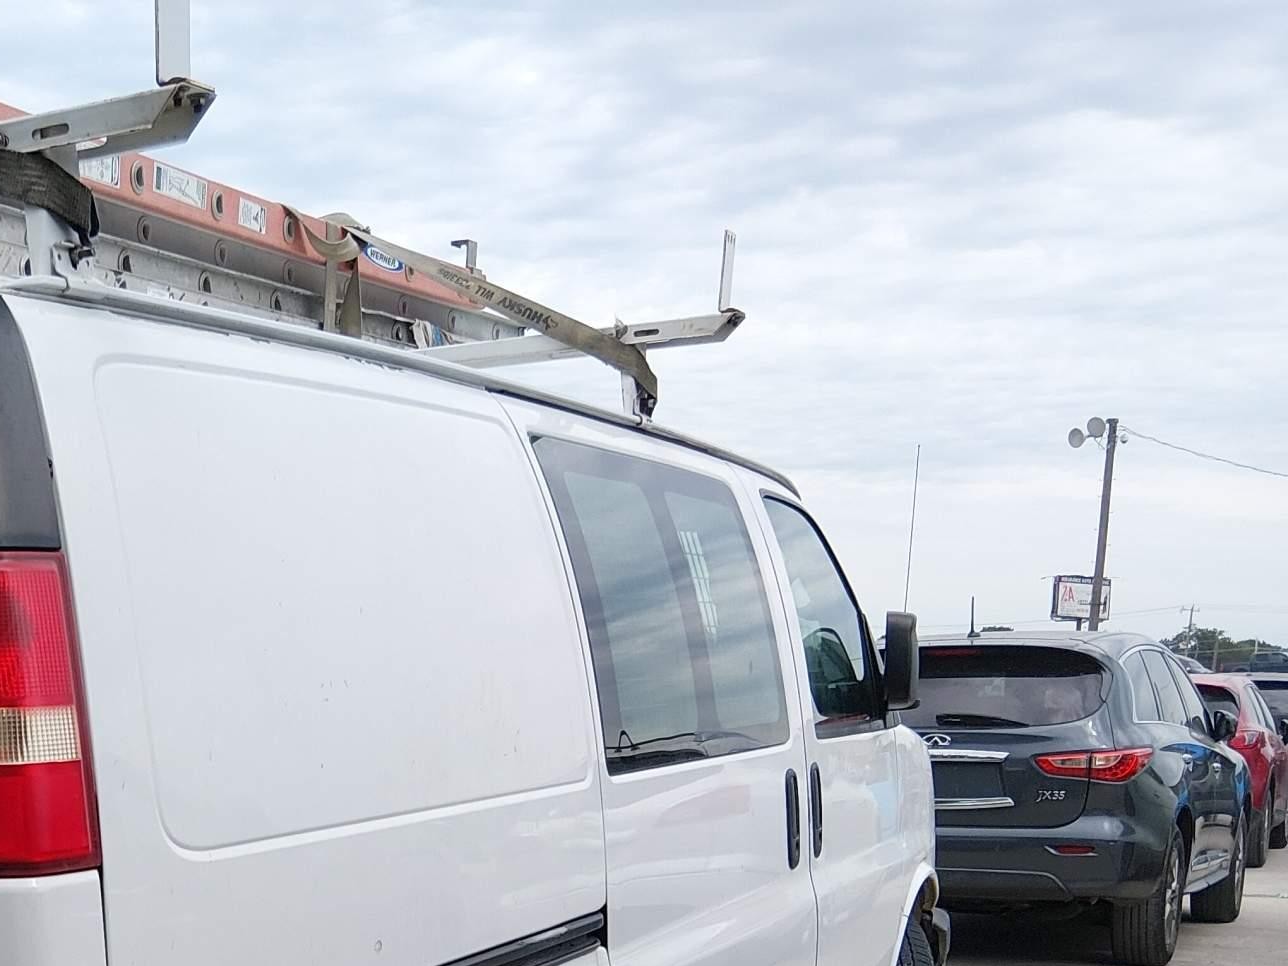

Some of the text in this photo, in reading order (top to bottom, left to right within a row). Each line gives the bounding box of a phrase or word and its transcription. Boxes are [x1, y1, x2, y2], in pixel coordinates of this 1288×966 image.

[369, 248, 397, 268] WERNER
[474, 285, 494, 301] WLL
[496, 296, 544, 324] HUSKY
[1036, 790, 1066, 802] JX35
